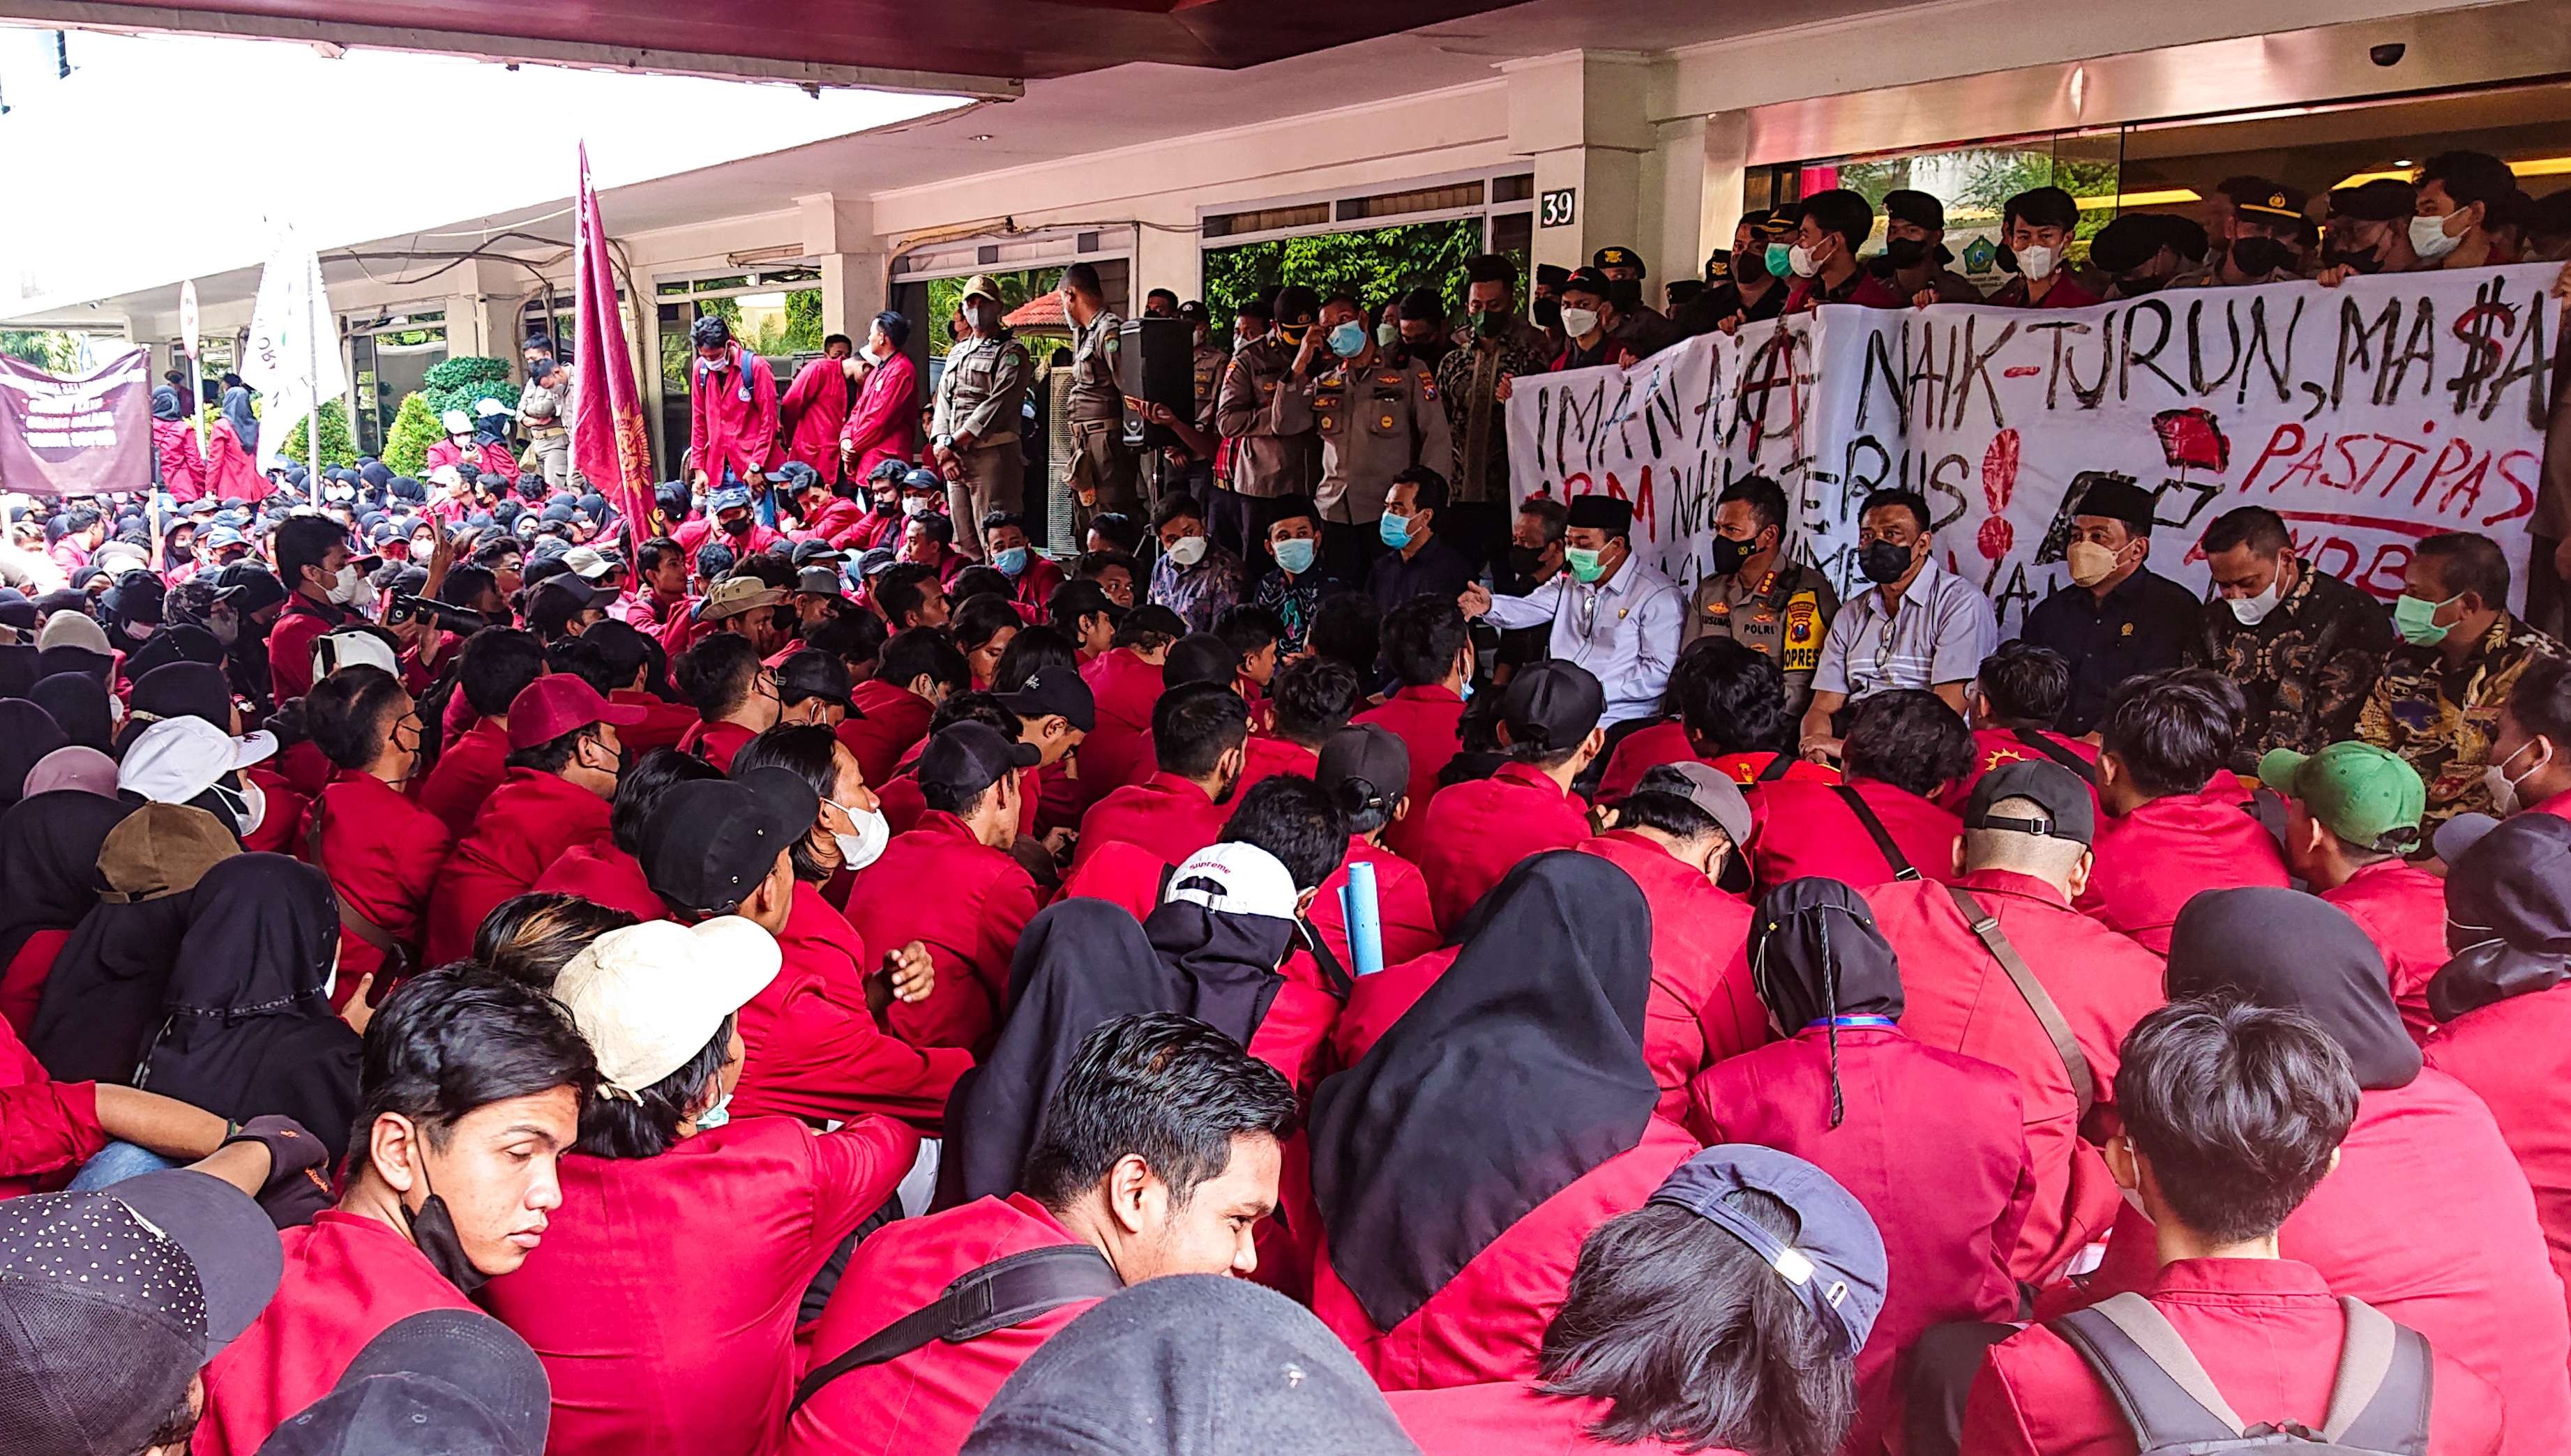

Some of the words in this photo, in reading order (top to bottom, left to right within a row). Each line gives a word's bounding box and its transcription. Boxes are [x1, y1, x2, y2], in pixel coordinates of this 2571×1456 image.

[1543, 192, 1573, 225] 39
[1537, 364, 1683, 478] IMAN
[1744, 624, 1774, 635] POLRI
[1189, 861, 1230, 874] Supreme
